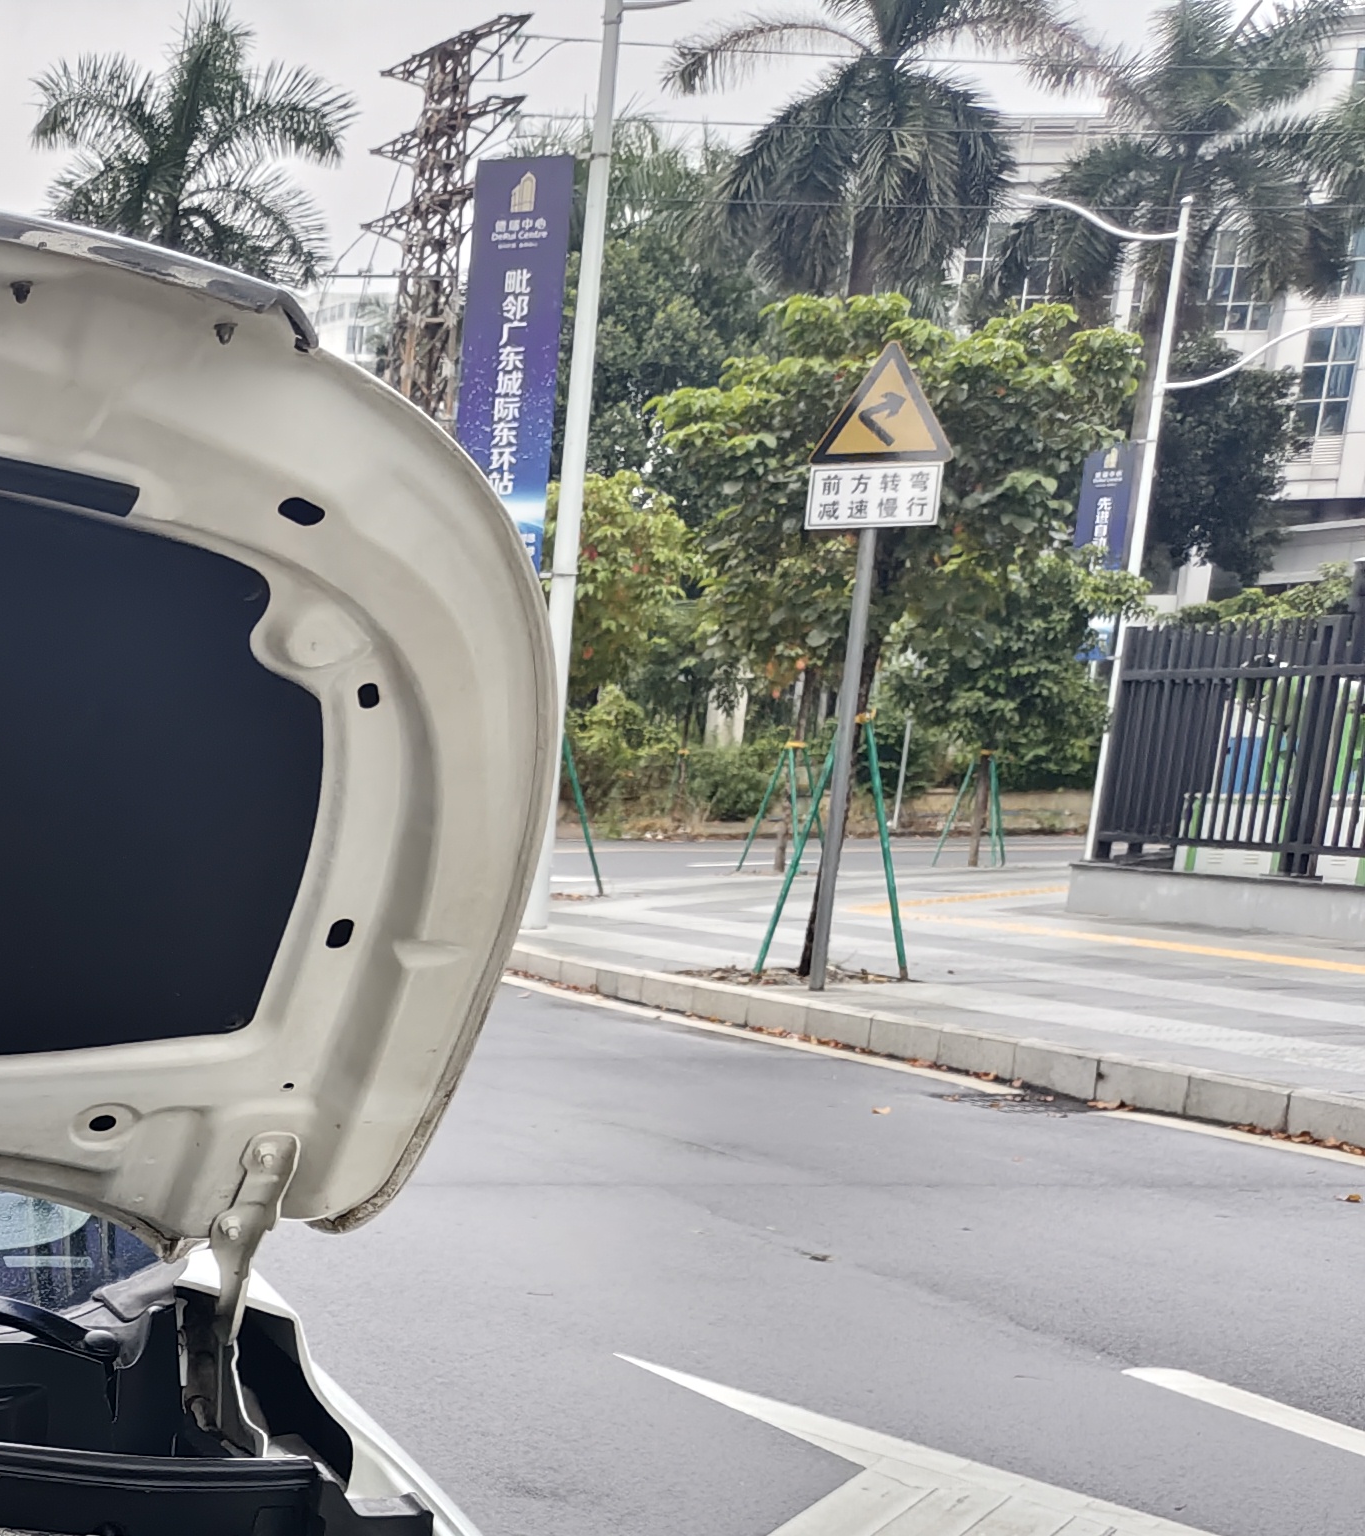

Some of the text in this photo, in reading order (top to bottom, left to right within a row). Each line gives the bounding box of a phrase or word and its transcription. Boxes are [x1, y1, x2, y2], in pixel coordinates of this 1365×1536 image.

[488, 269, 531, 495] 毗邻广东城际东环站
[821, 471, 930, 496] 前方转弯
[817, 497, 928, 521] 减速慢行
